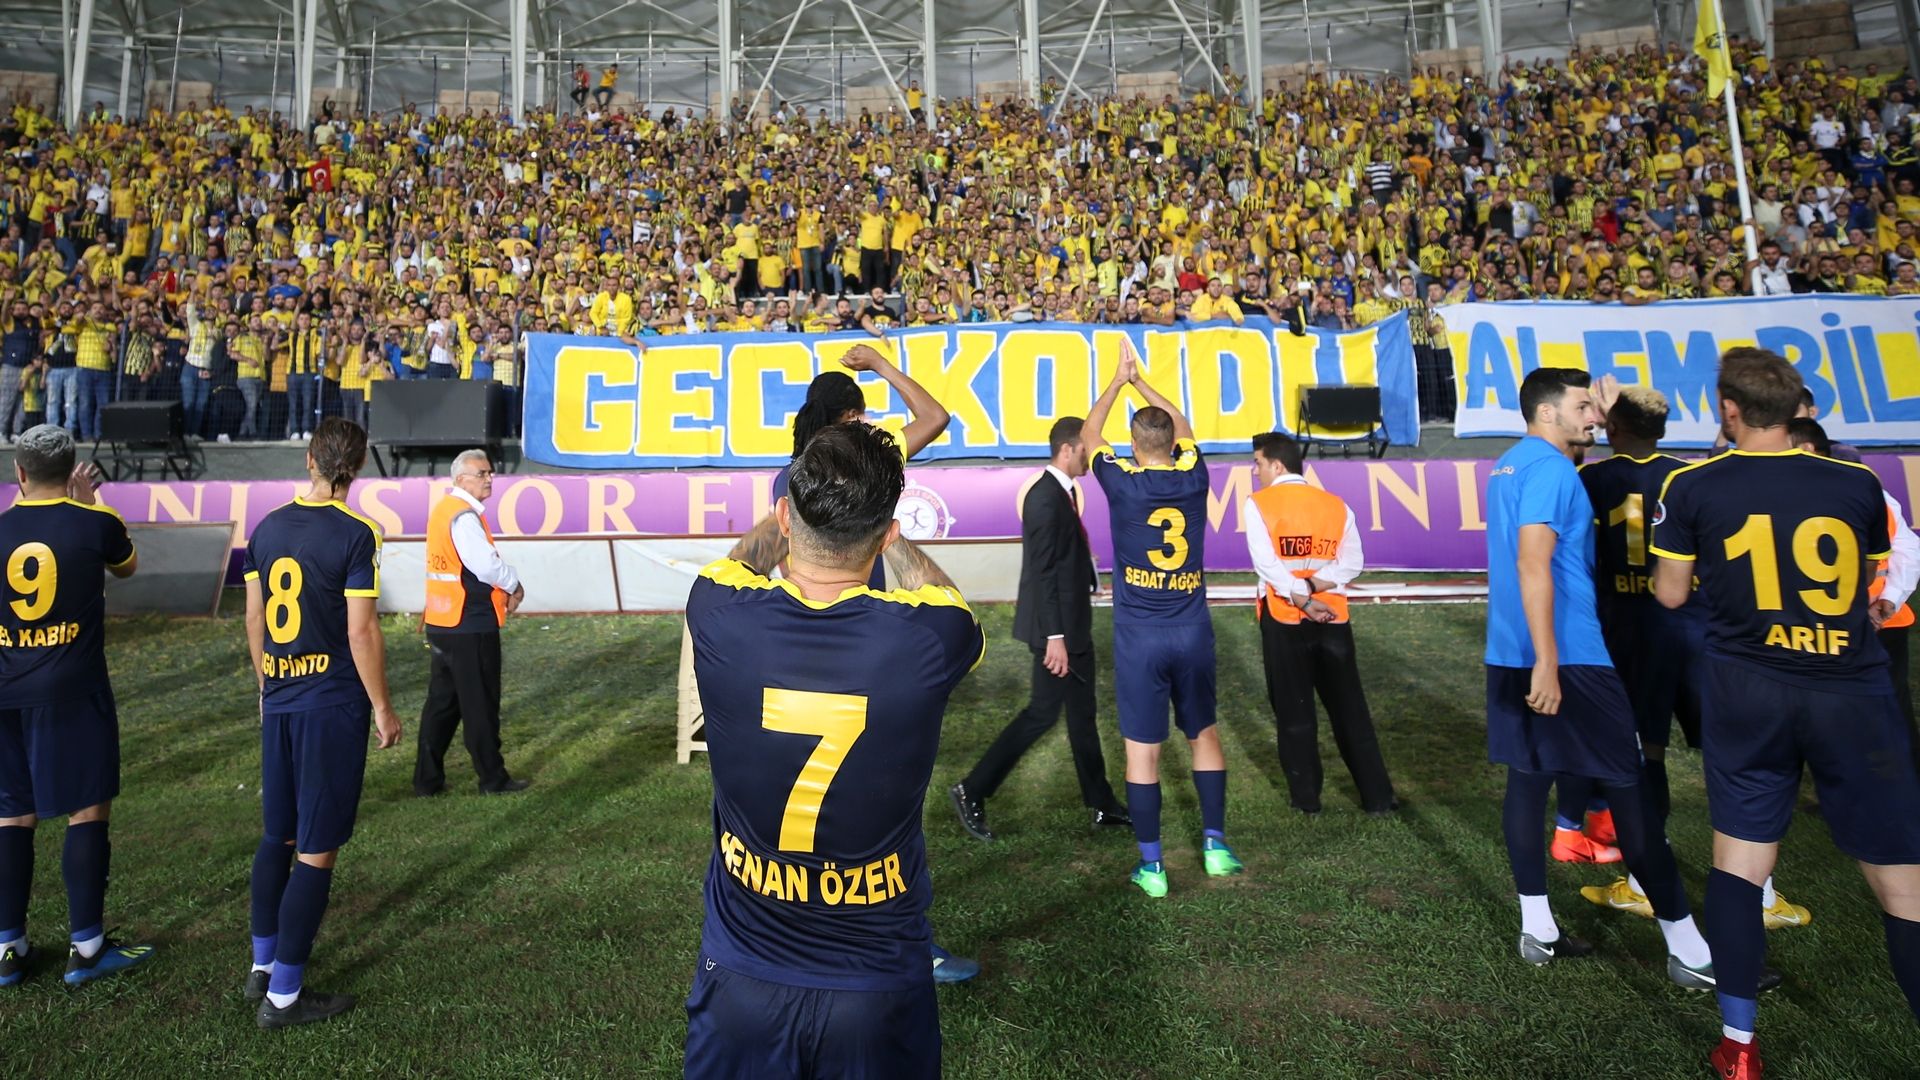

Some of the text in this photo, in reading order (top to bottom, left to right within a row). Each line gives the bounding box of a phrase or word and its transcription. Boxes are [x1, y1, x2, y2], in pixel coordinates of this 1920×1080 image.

[552, 326, 1382, 457] GECEKONDU
[1147, 507, 1189, 571] 3
[1723, 514, 1860, 616] 19
[7, 541, 57, 621] 9
[266, 556, 303, 644] 8
[1125, 566, 1166, 589] SEDAT
[18, 622, 81, 648] KABİR
[279, 654, 329, 679] PİNTO
[1765, 623, 1849, 655] ARİF
[762, 687, 868, 853] 7
[820, 852, 907, 905] ÖZER
